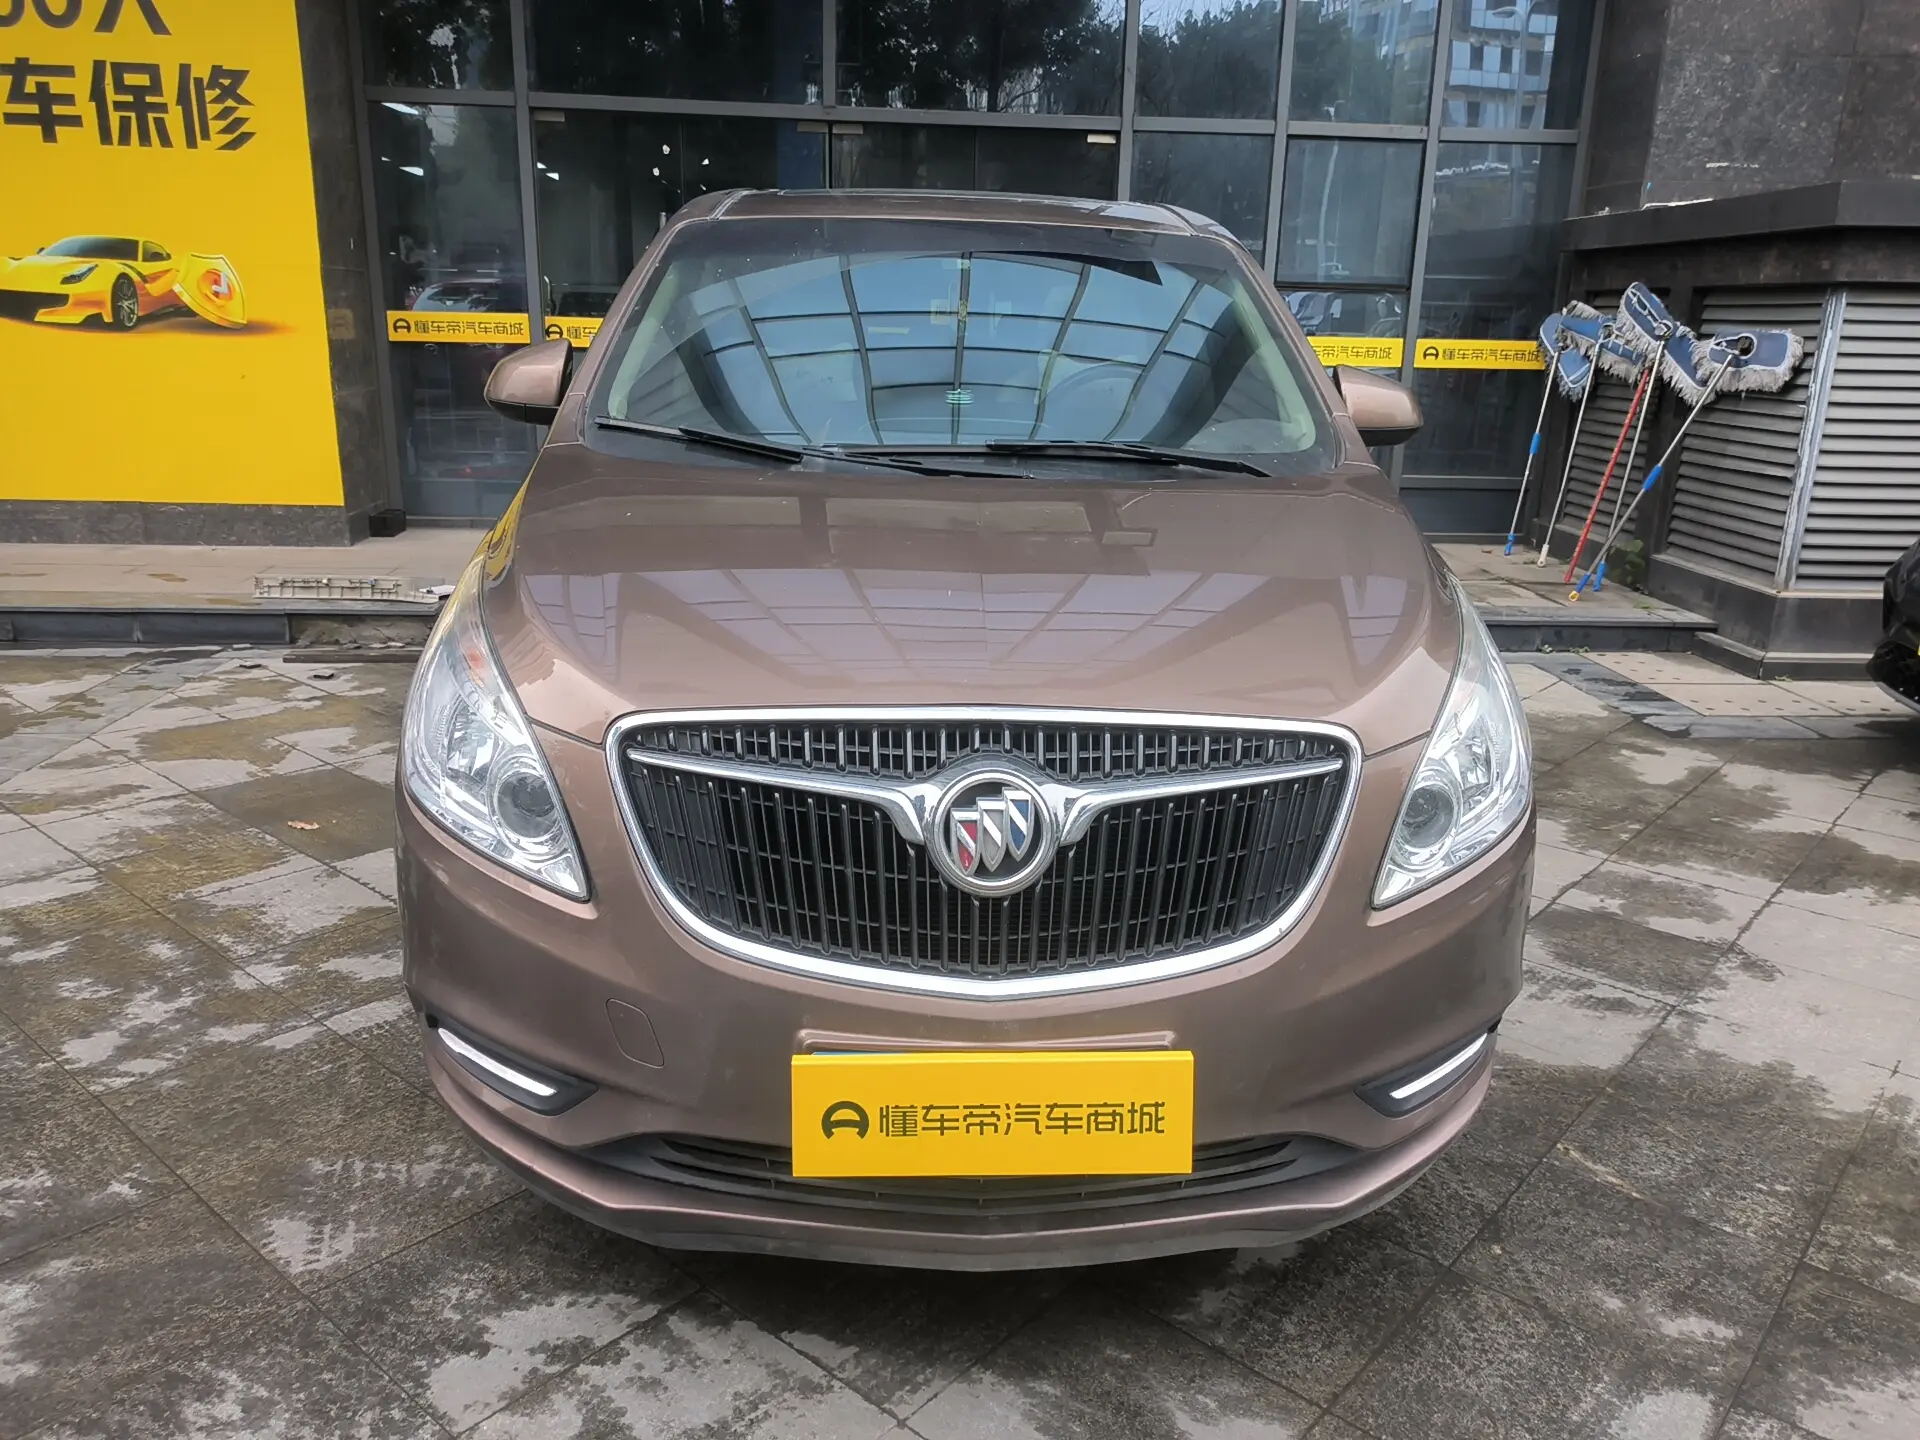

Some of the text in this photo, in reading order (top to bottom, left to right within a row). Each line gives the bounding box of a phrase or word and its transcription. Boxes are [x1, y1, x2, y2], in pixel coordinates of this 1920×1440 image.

[0, 57, 258, 151] 车保修
[414, 320, 524, 336] 懂车帝汽车商城
[1443, 347, 1541, 362] 懂车帝汽车商城
[879, 1101, 1165, 1137] 懂车帝汽车商城
